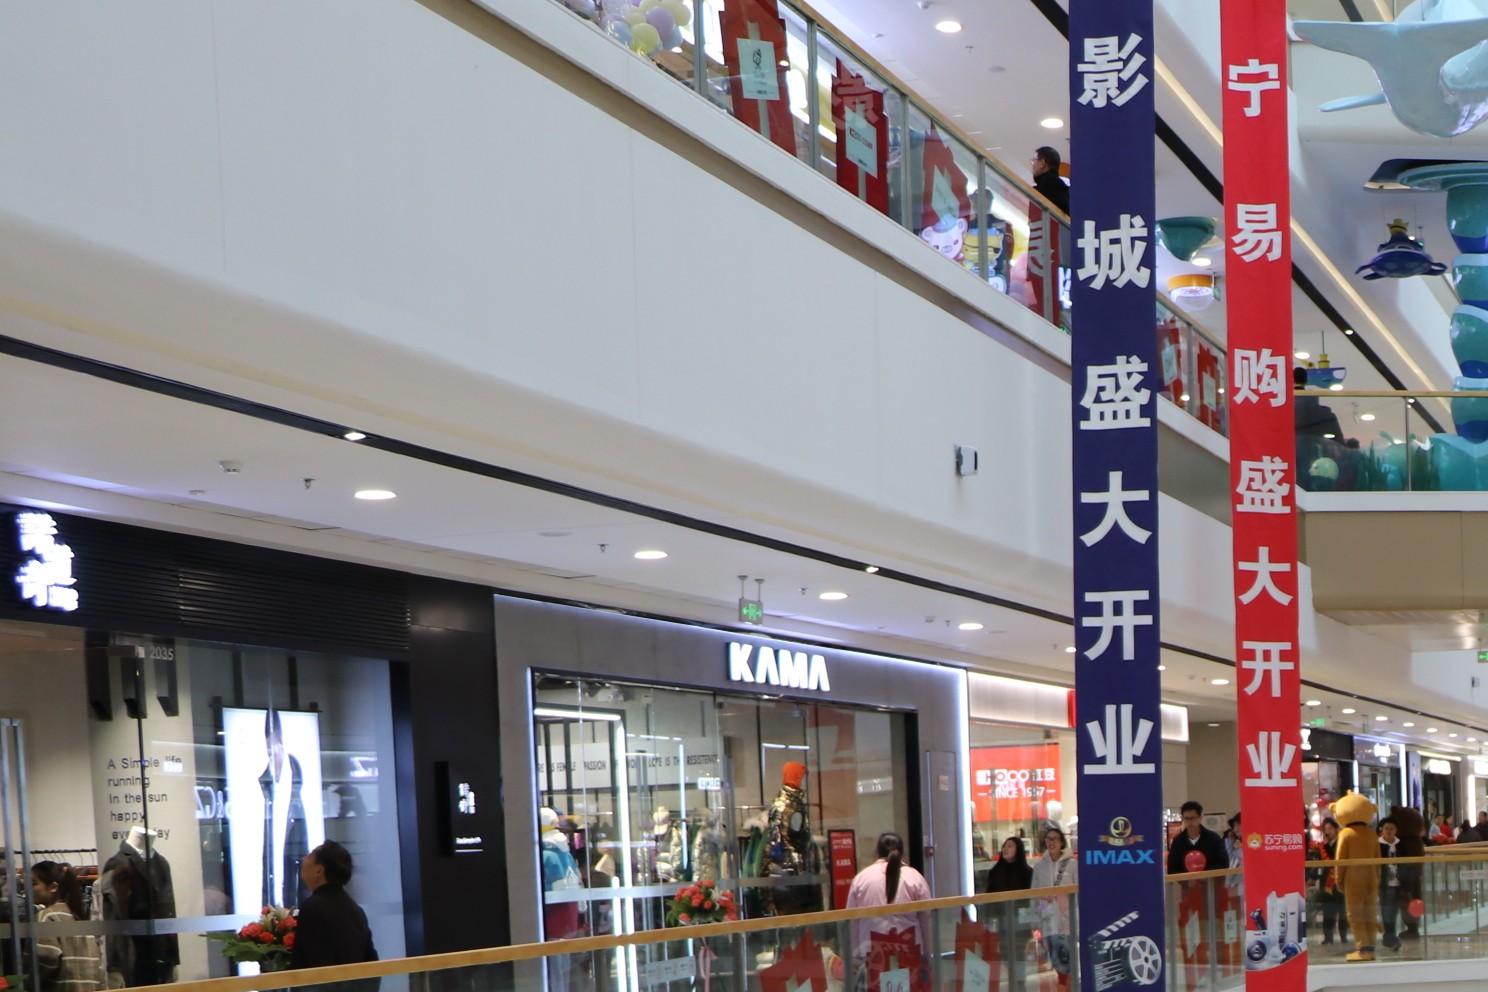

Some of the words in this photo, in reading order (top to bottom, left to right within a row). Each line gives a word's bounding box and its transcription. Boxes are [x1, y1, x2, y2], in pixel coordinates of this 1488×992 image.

[1077, 33, 1156, 775] 影城盛大开业
[1227, 59, 1297, 787] 宁易购盛大开业
[150, 646, 174, 661] 2035
[729, 641, 831, 692] KAMA
[107, 758, 116, 769] A
[124, 792, 142, 803] the
[148, 792, 168, 802] sun
[110, 811, 145, 823] happy
[1264, 833, 1303, 844] 苏宁易购
[1264, 843, 1304, 852] suning.com
[1085, 849, 1156, 865] IMAX
